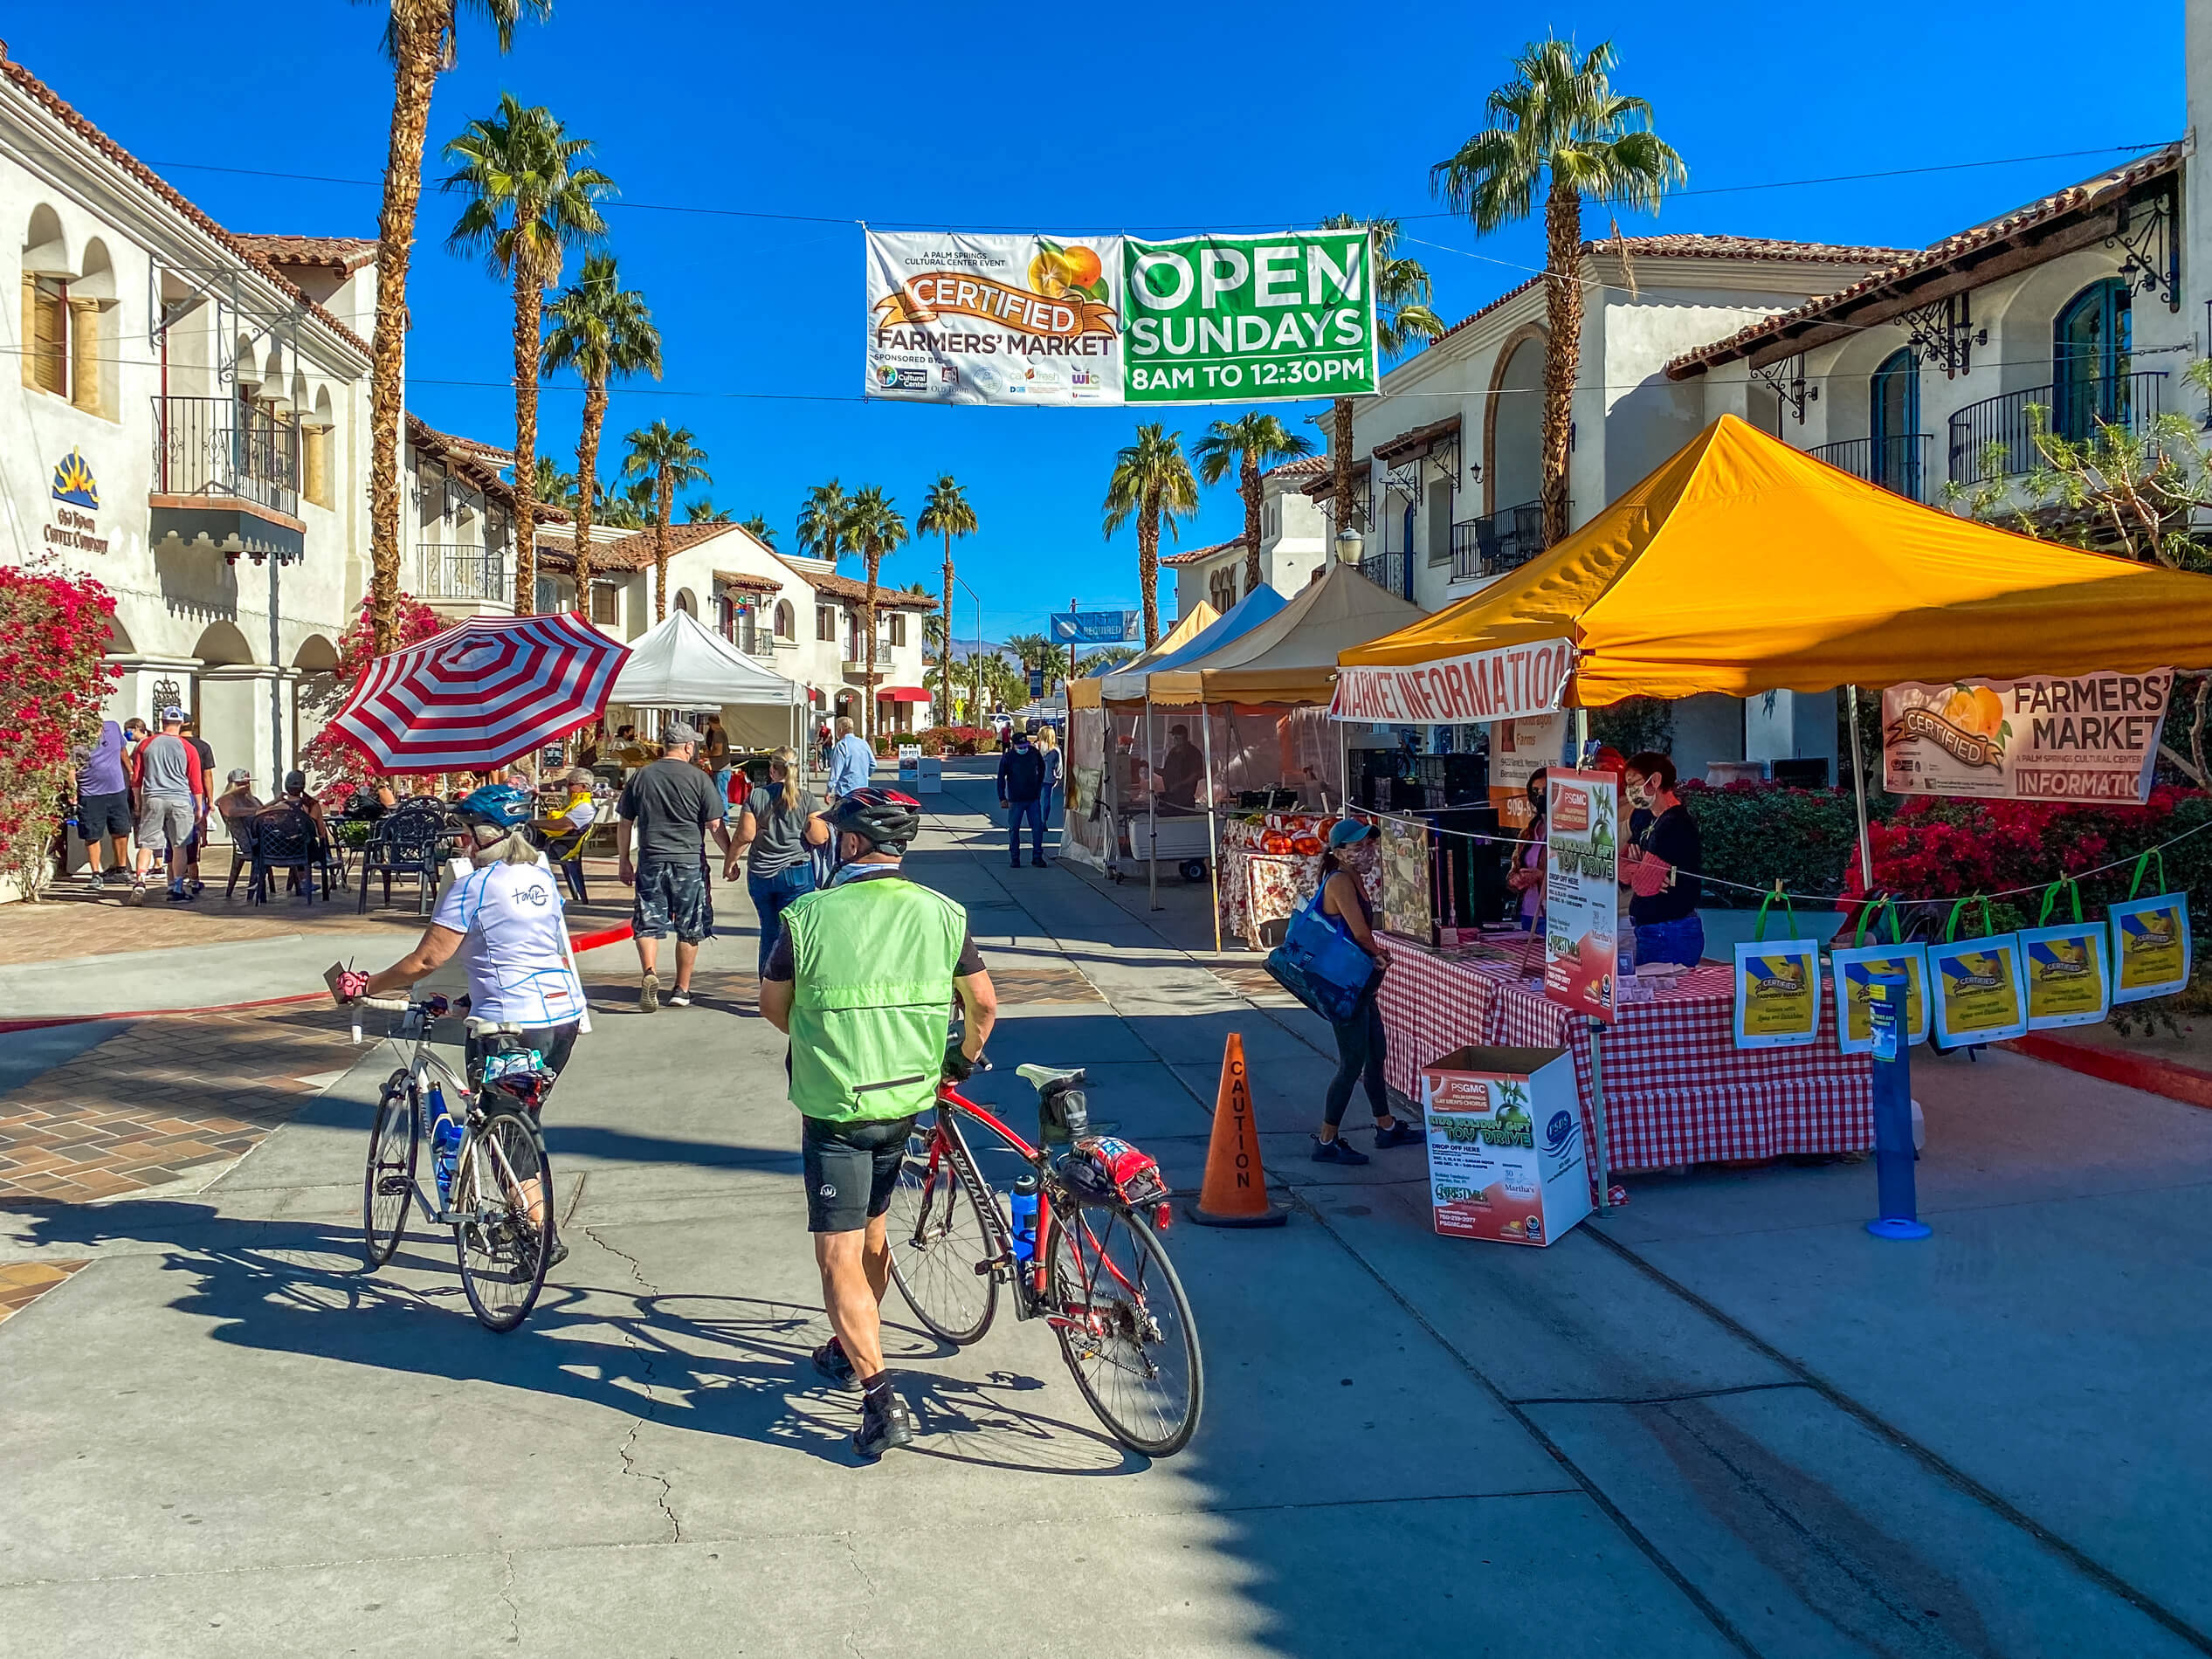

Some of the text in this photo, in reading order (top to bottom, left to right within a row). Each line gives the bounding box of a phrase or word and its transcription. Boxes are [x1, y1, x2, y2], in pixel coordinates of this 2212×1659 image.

[905, 258, 946, 266] CULTURAL
[947, 258, 978, 267] CENTER
[954, 251, 987, 260] SPRINGS
[1131, 244, 1361, 311] OPEN
[912, 278, 1076, 333] CERTIFIED
[1131, 308, 1365, 356] SUNDAYS
[877, 327, 1113, 357] FARMERS' MARKET
[874, 353, 926, 363] SPONSORED
[898, 373, 927, 382] Cultural
[1132, 357, 1365, 390] 8AM TO 12:30PM
[1083, 625, 1122, 637] REQUIRED
[1332, 671, 1403, 719] MARKET
[2013, 675, 2171, 714] FARMERS'
[1516, 733, 1536, 746] Farms
[1905, 711, 1982, 763] CERTIFIED
[2032, 714, 2161, 750] MARKET
[2043, 754, 2073, 763] SPRINGS
[1564, 792, 1587, 806] PSGMC
[1597, 843, 1616, 860] GIFT
[1557, 850, 1615, 880] TOY DRIVE
[2047, 962, 2081, 972] CERTIFIED
[1763, 979, 1796, 990] CERTIFIED
[1960, 977, 1996, 986] CERTIFIED
[1451, 1083, 1486, 1094] PSGMC
[1463, 1099, 1488, 1108] CHORUS
[1230, 1060, 1251, 1188] CAUTION
[1429, 1115, 1532, 1133] KIDS HOLIDAY GIFT
[1444, 1126, 1533, 1147] TOY DRIVE
[1505, 1183, 1535, 1194] Martha's
